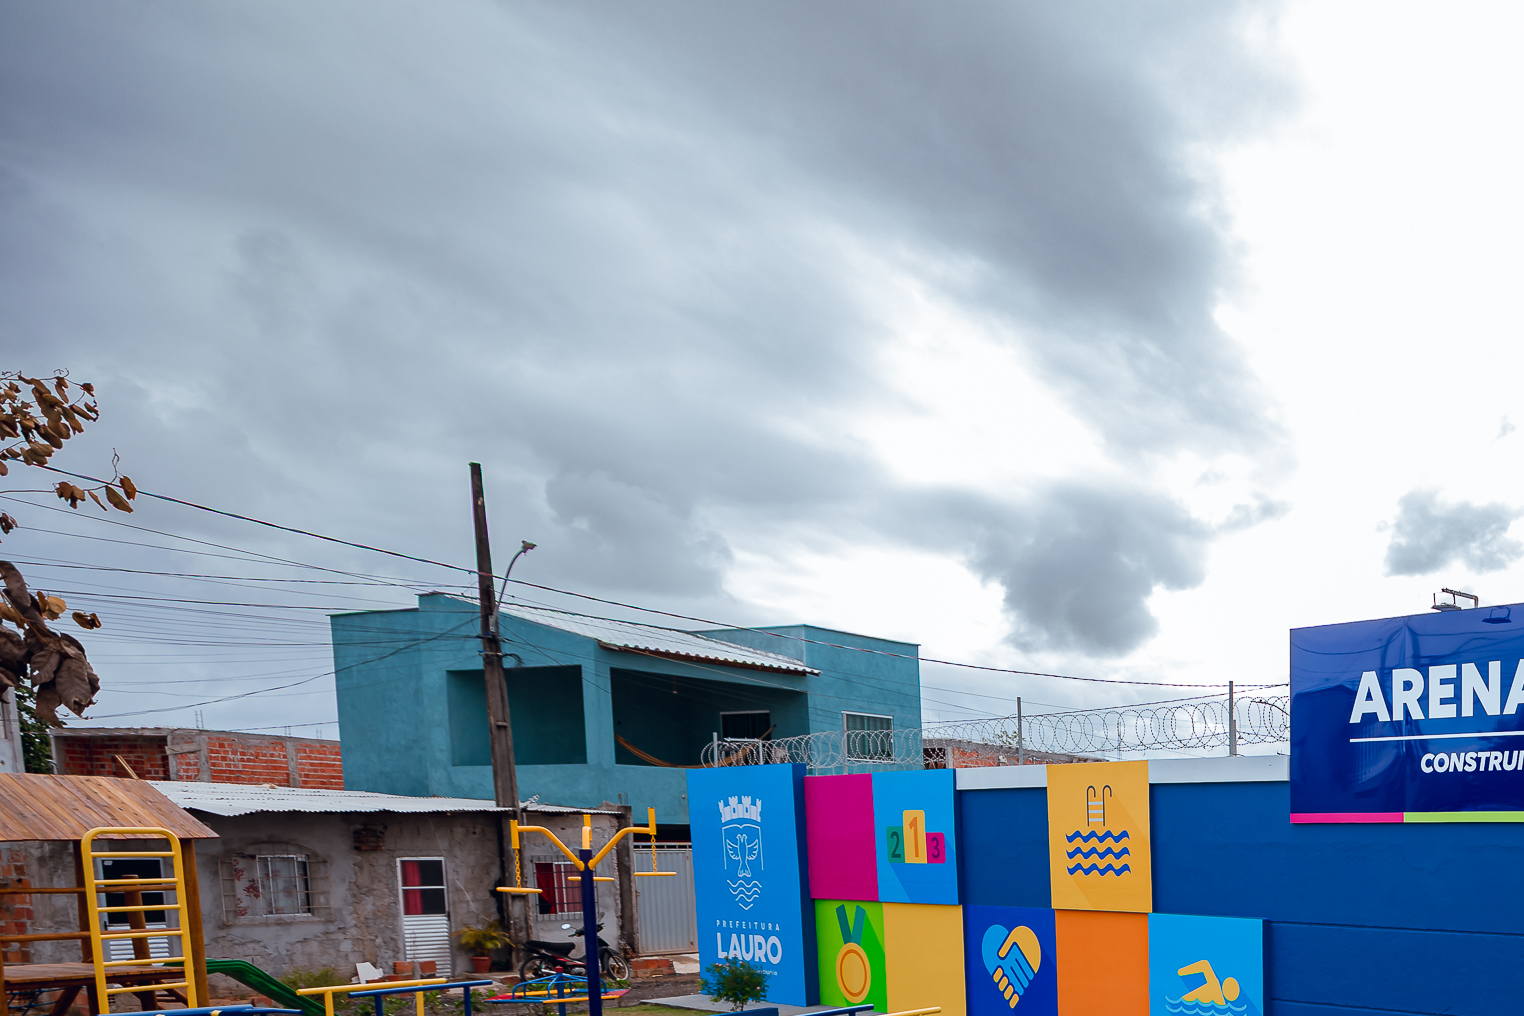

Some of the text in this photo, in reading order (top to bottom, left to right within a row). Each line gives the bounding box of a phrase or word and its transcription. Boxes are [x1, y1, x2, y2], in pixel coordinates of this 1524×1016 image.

[890, 816, 941, 860] 2 1 3
[716, 919, 780, 932] PREFEITURA
[716, 931, 783, 965] LAURO
